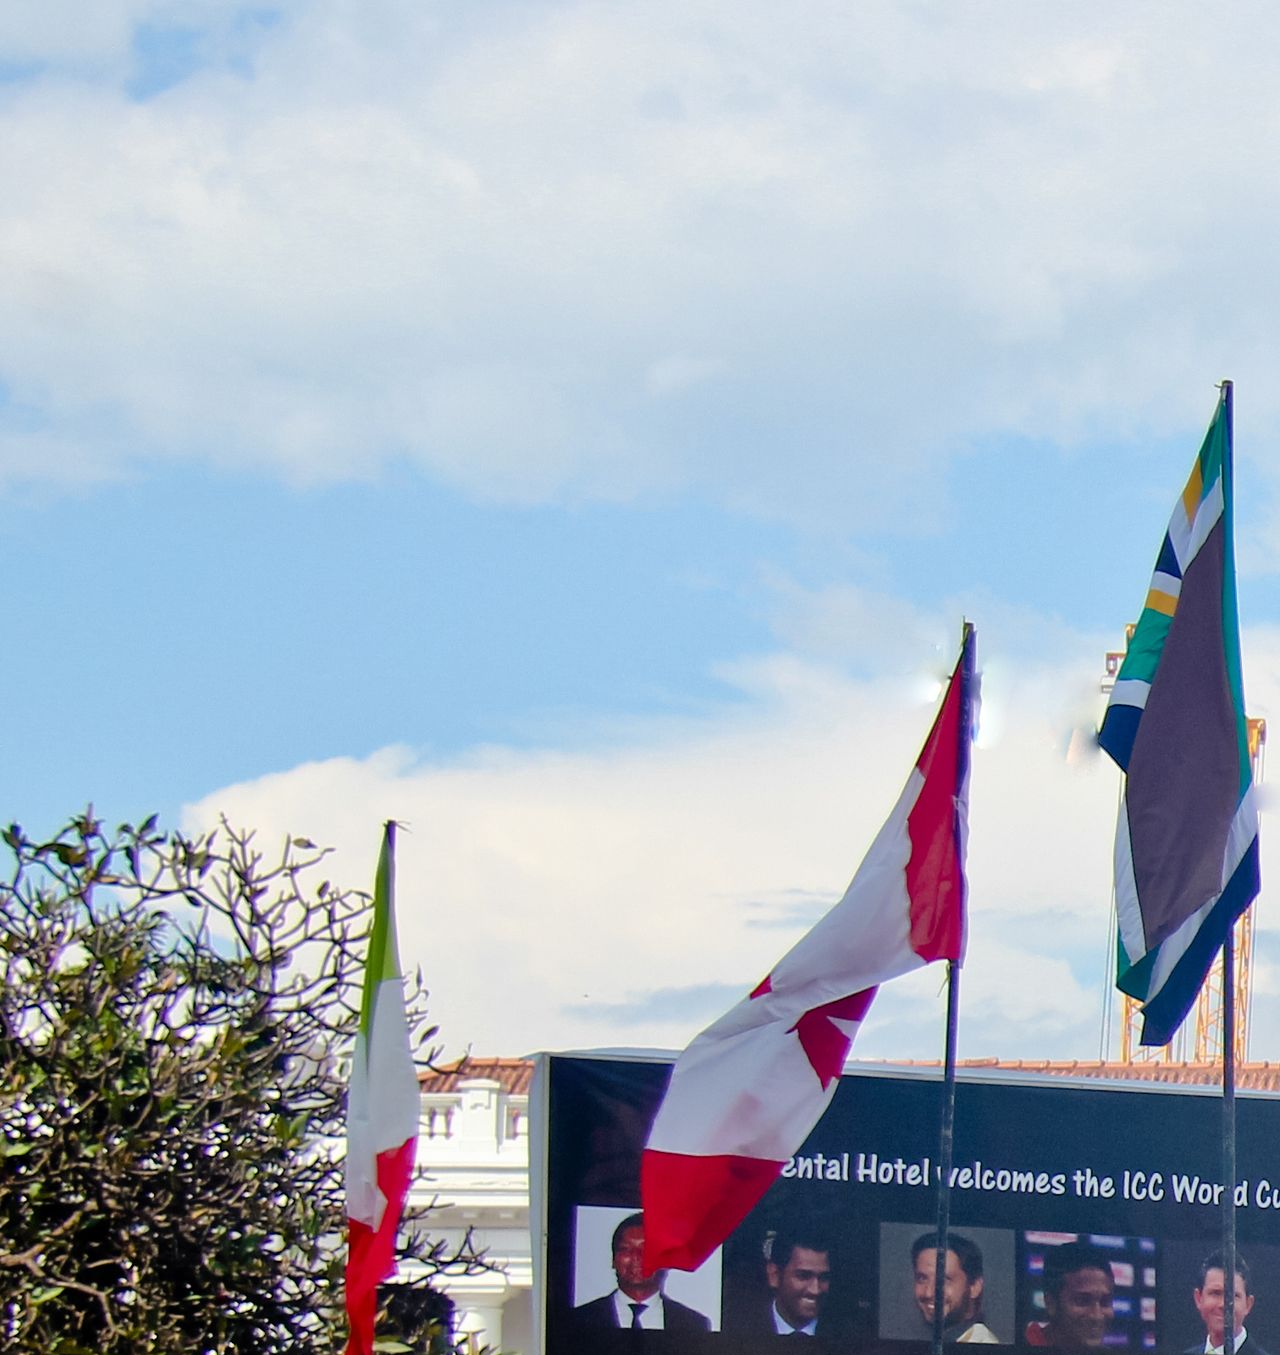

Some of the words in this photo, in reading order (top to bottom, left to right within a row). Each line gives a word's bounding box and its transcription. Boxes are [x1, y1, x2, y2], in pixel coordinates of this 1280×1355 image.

[857, 1153, 930, 1186] Hotel
[1073, 1168, 1115, 1198] the
[1123, 1169, 1164, 1201] ICC
[1171, 1174, 1248, 1206] Word
